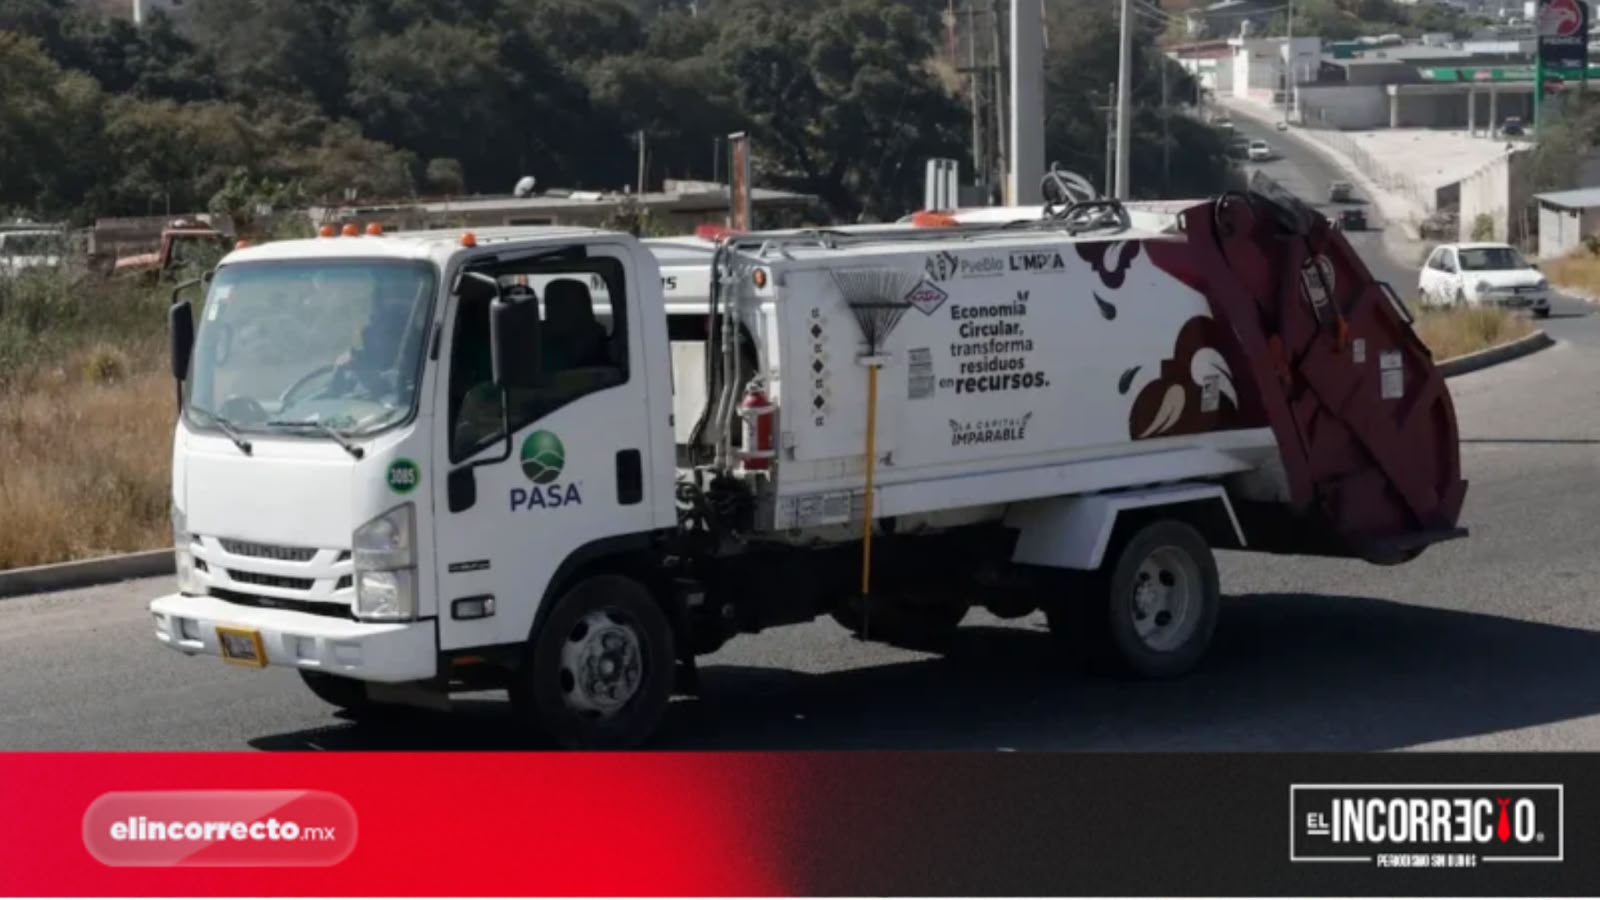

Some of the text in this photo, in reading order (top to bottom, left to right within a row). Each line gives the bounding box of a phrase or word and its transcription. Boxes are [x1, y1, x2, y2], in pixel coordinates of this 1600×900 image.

[959, 320, 1024, 339] Circular,
[950, 339, 1034, 357] transforma
[960, 356, 1025, 374] residuos
[939, 371, 1050, 394] en recursos.
[952, 427, 1025, 446] IMPARABLE
[510, 483, 582, 512] PASA
